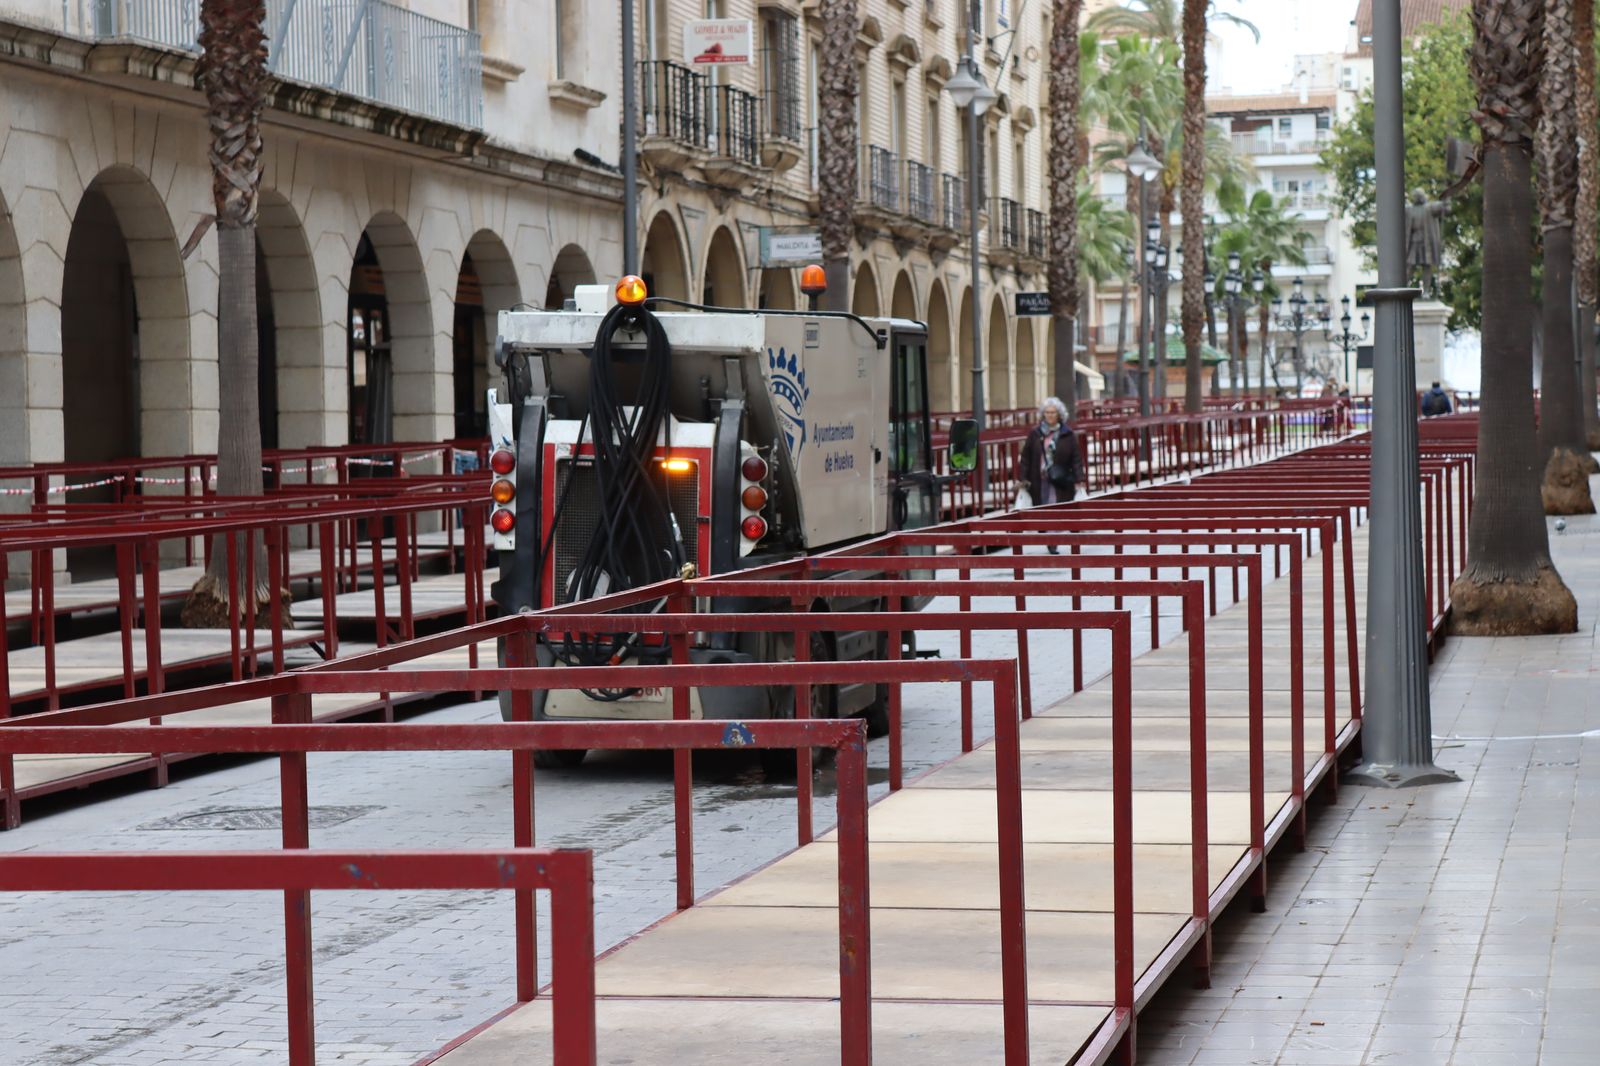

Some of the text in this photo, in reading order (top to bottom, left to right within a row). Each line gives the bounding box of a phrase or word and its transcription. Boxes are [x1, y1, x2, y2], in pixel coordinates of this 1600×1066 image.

[813, 421, 855, 448] Ayuntamiento
[824, 450, 854, 473] de Huelva
